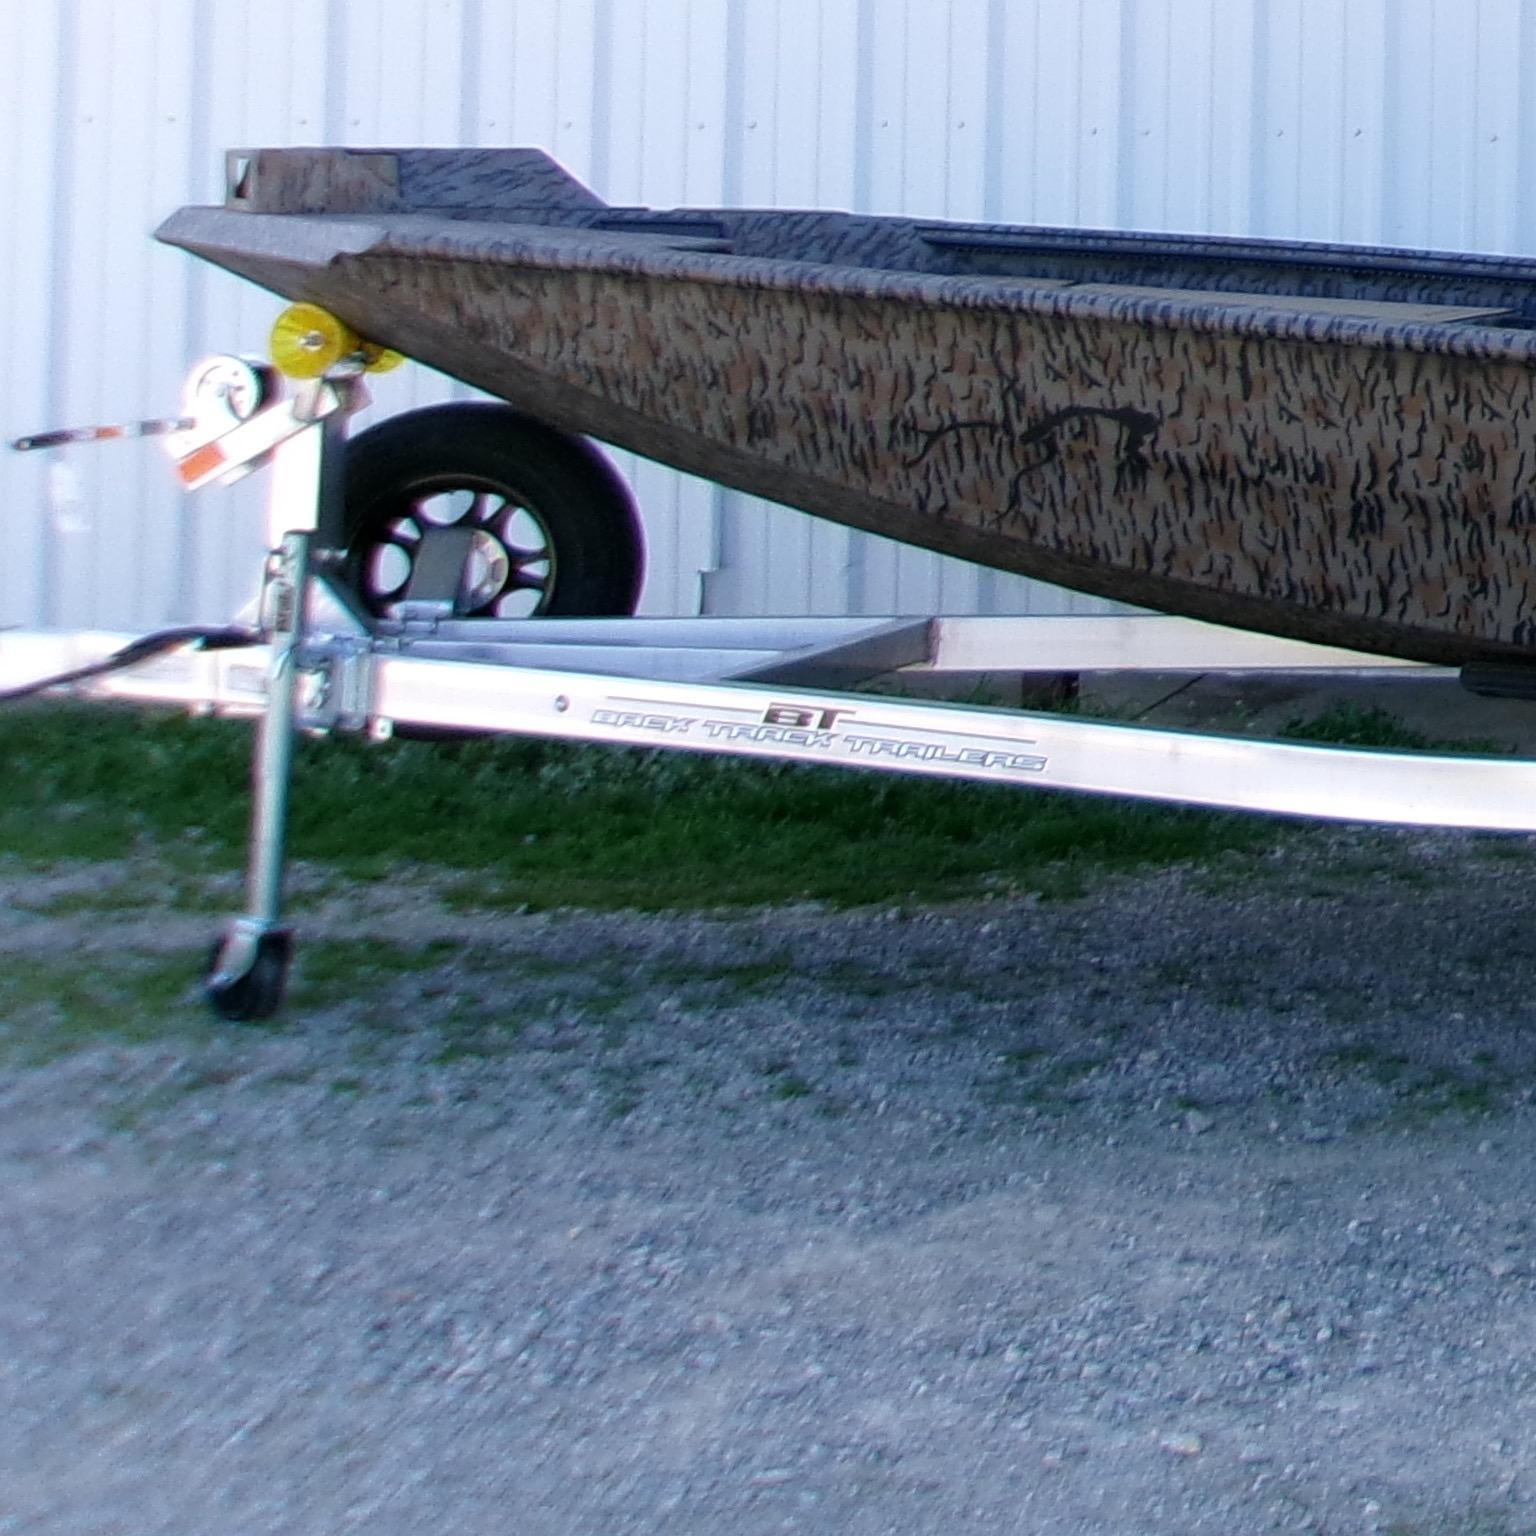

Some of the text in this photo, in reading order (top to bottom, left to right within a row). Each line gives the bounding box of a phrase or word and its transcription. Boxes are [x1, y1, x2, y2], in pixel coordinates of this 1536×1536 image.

[591, 709, 1048, 772] BACK TRACK TRAILERS
